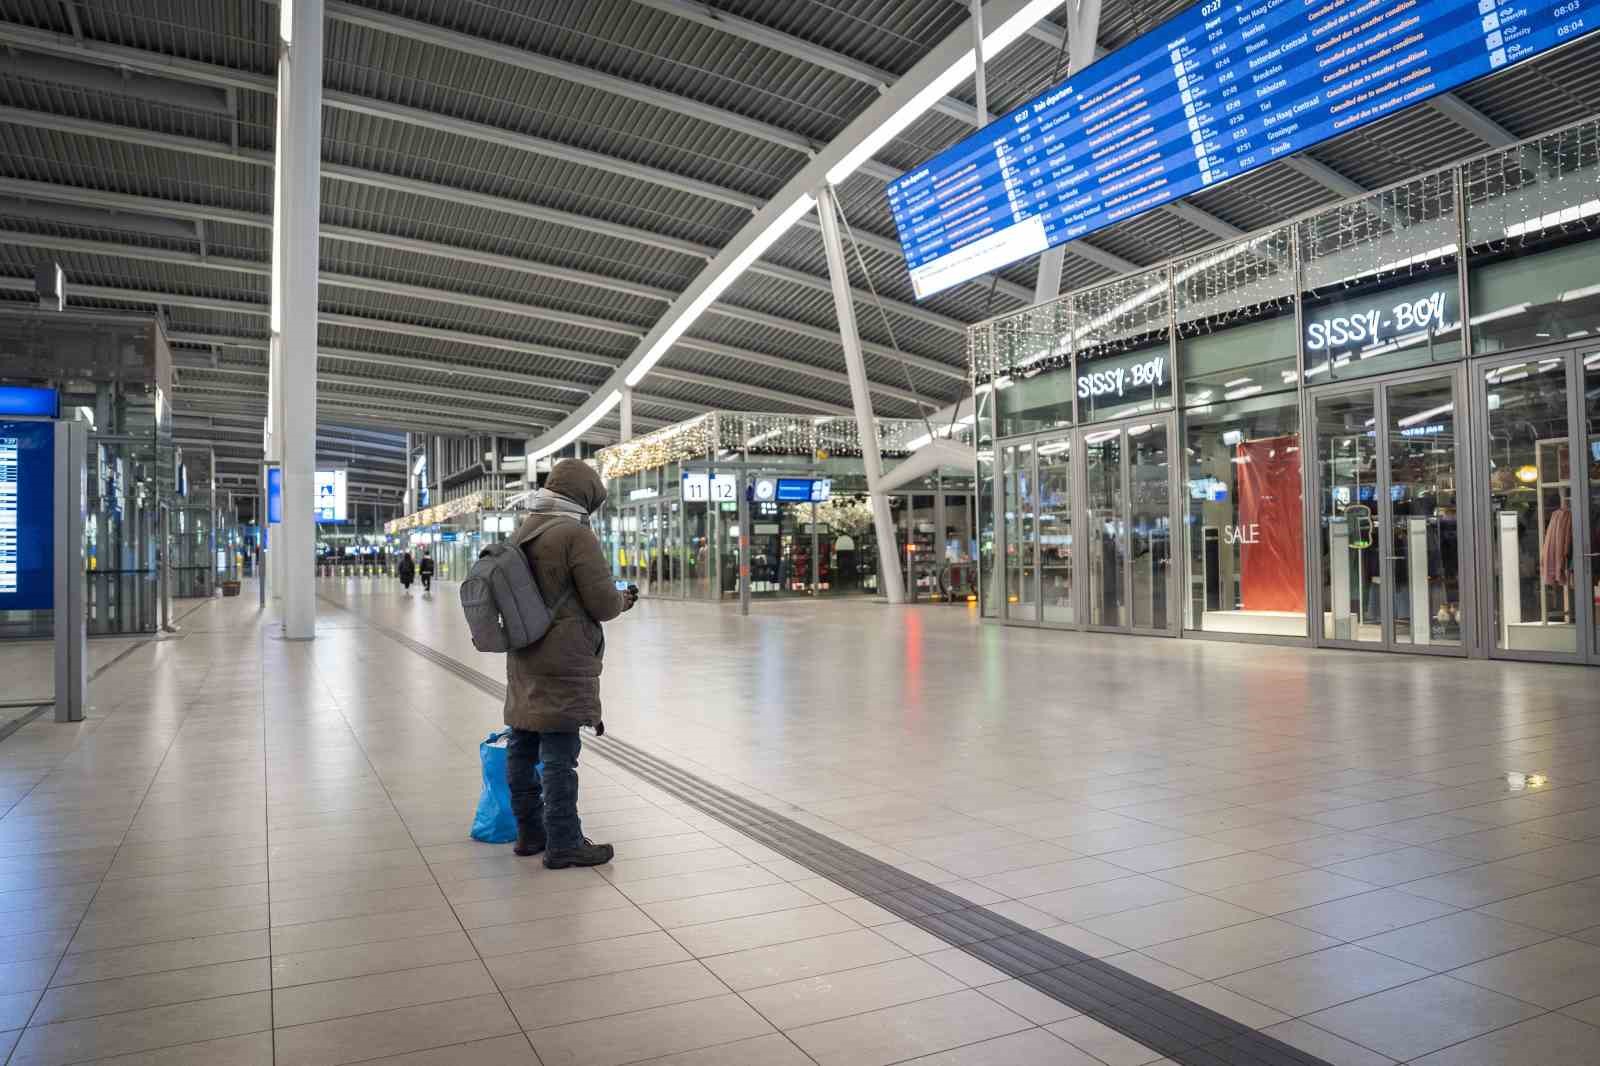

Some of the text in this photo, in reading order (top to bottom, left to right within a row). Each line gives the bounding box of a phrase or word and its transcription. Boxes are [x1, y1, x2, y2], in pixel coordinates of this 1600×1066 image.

[1553, 0, 1580, 17] 08:03
[1557, 19, 1584, 36] 08:04
[688, 484, 702, 498] 11
[717, 484, 732, 498] 12
[1224, 524, 1261, 544] SALE
